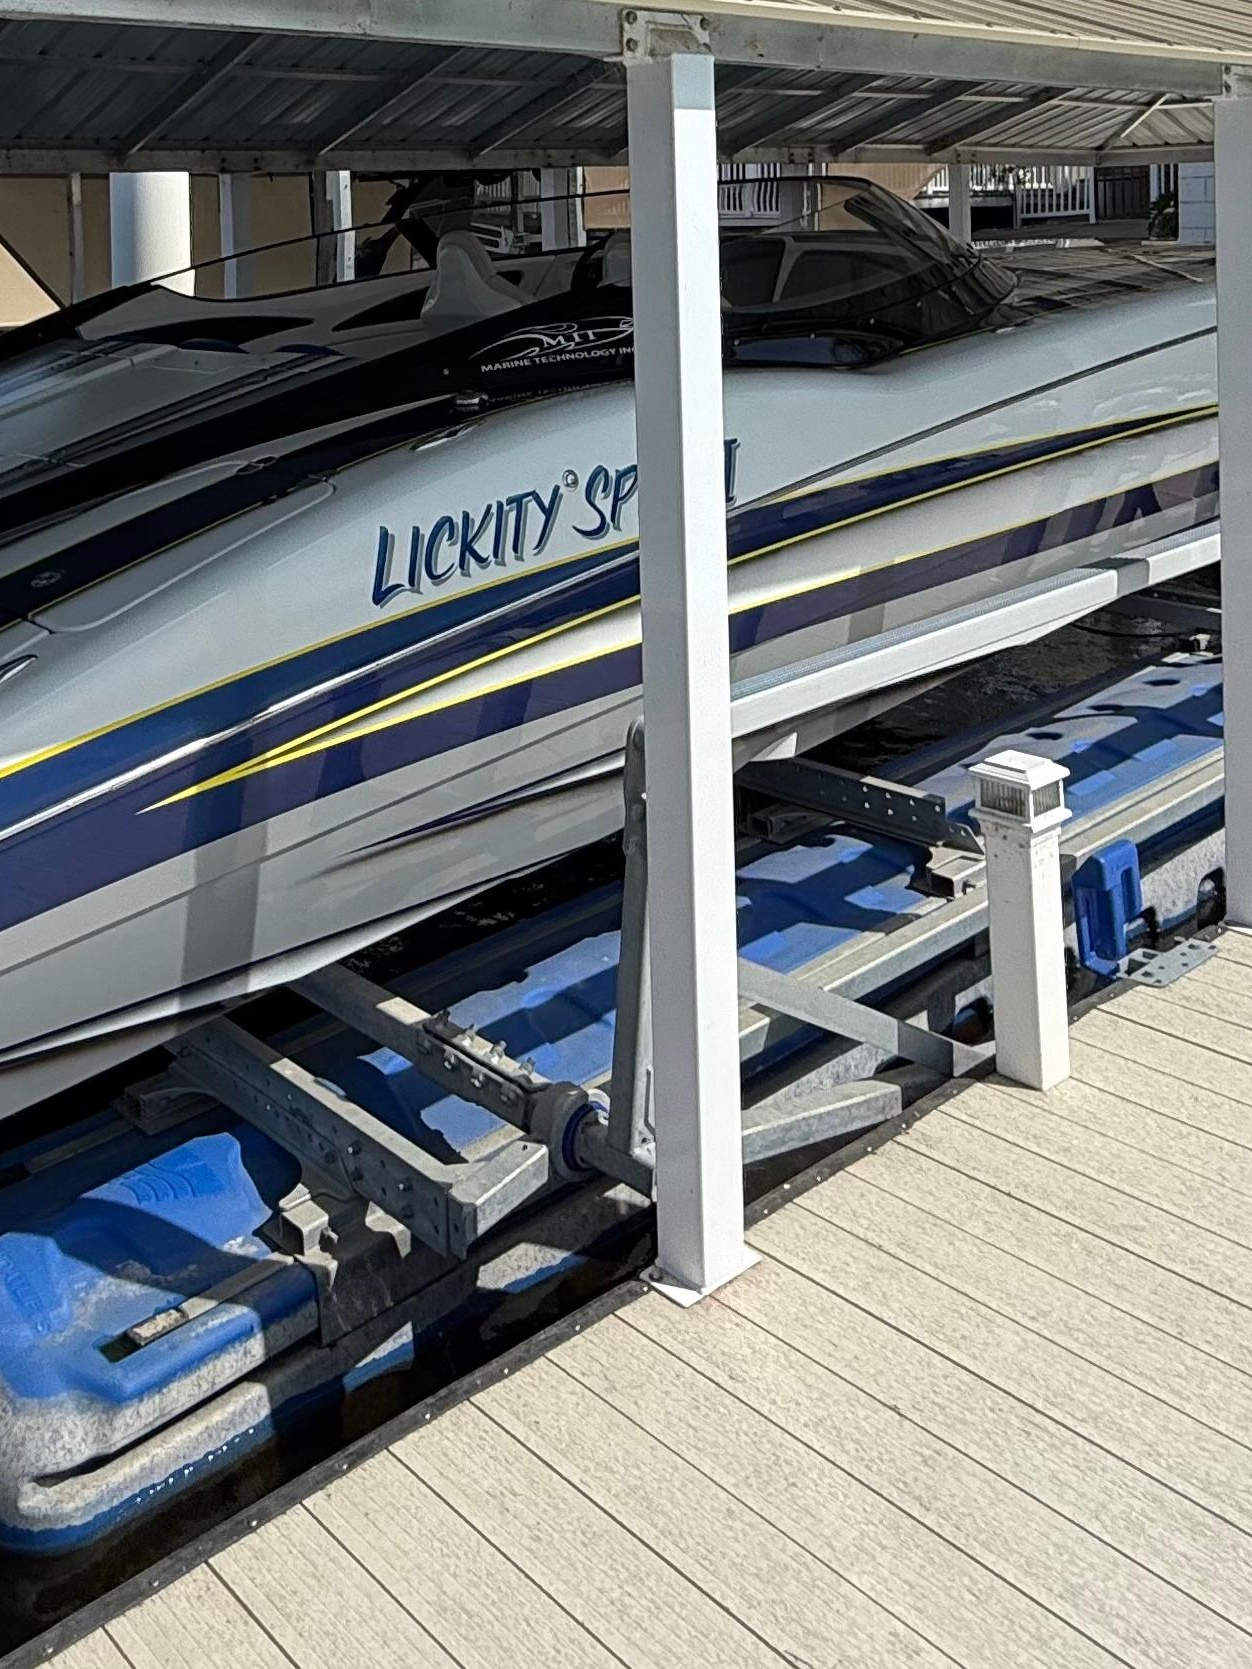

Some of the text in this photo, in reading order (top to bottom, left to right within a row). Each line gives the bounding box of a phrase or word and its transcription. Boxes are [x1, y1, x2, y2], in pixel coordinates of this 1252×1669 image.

[481, 358, 532, 372] MARINE
[533, 348, 617, 365] TECHNOLOGY
[372, 438, 741, 608] LICKITY SPT
